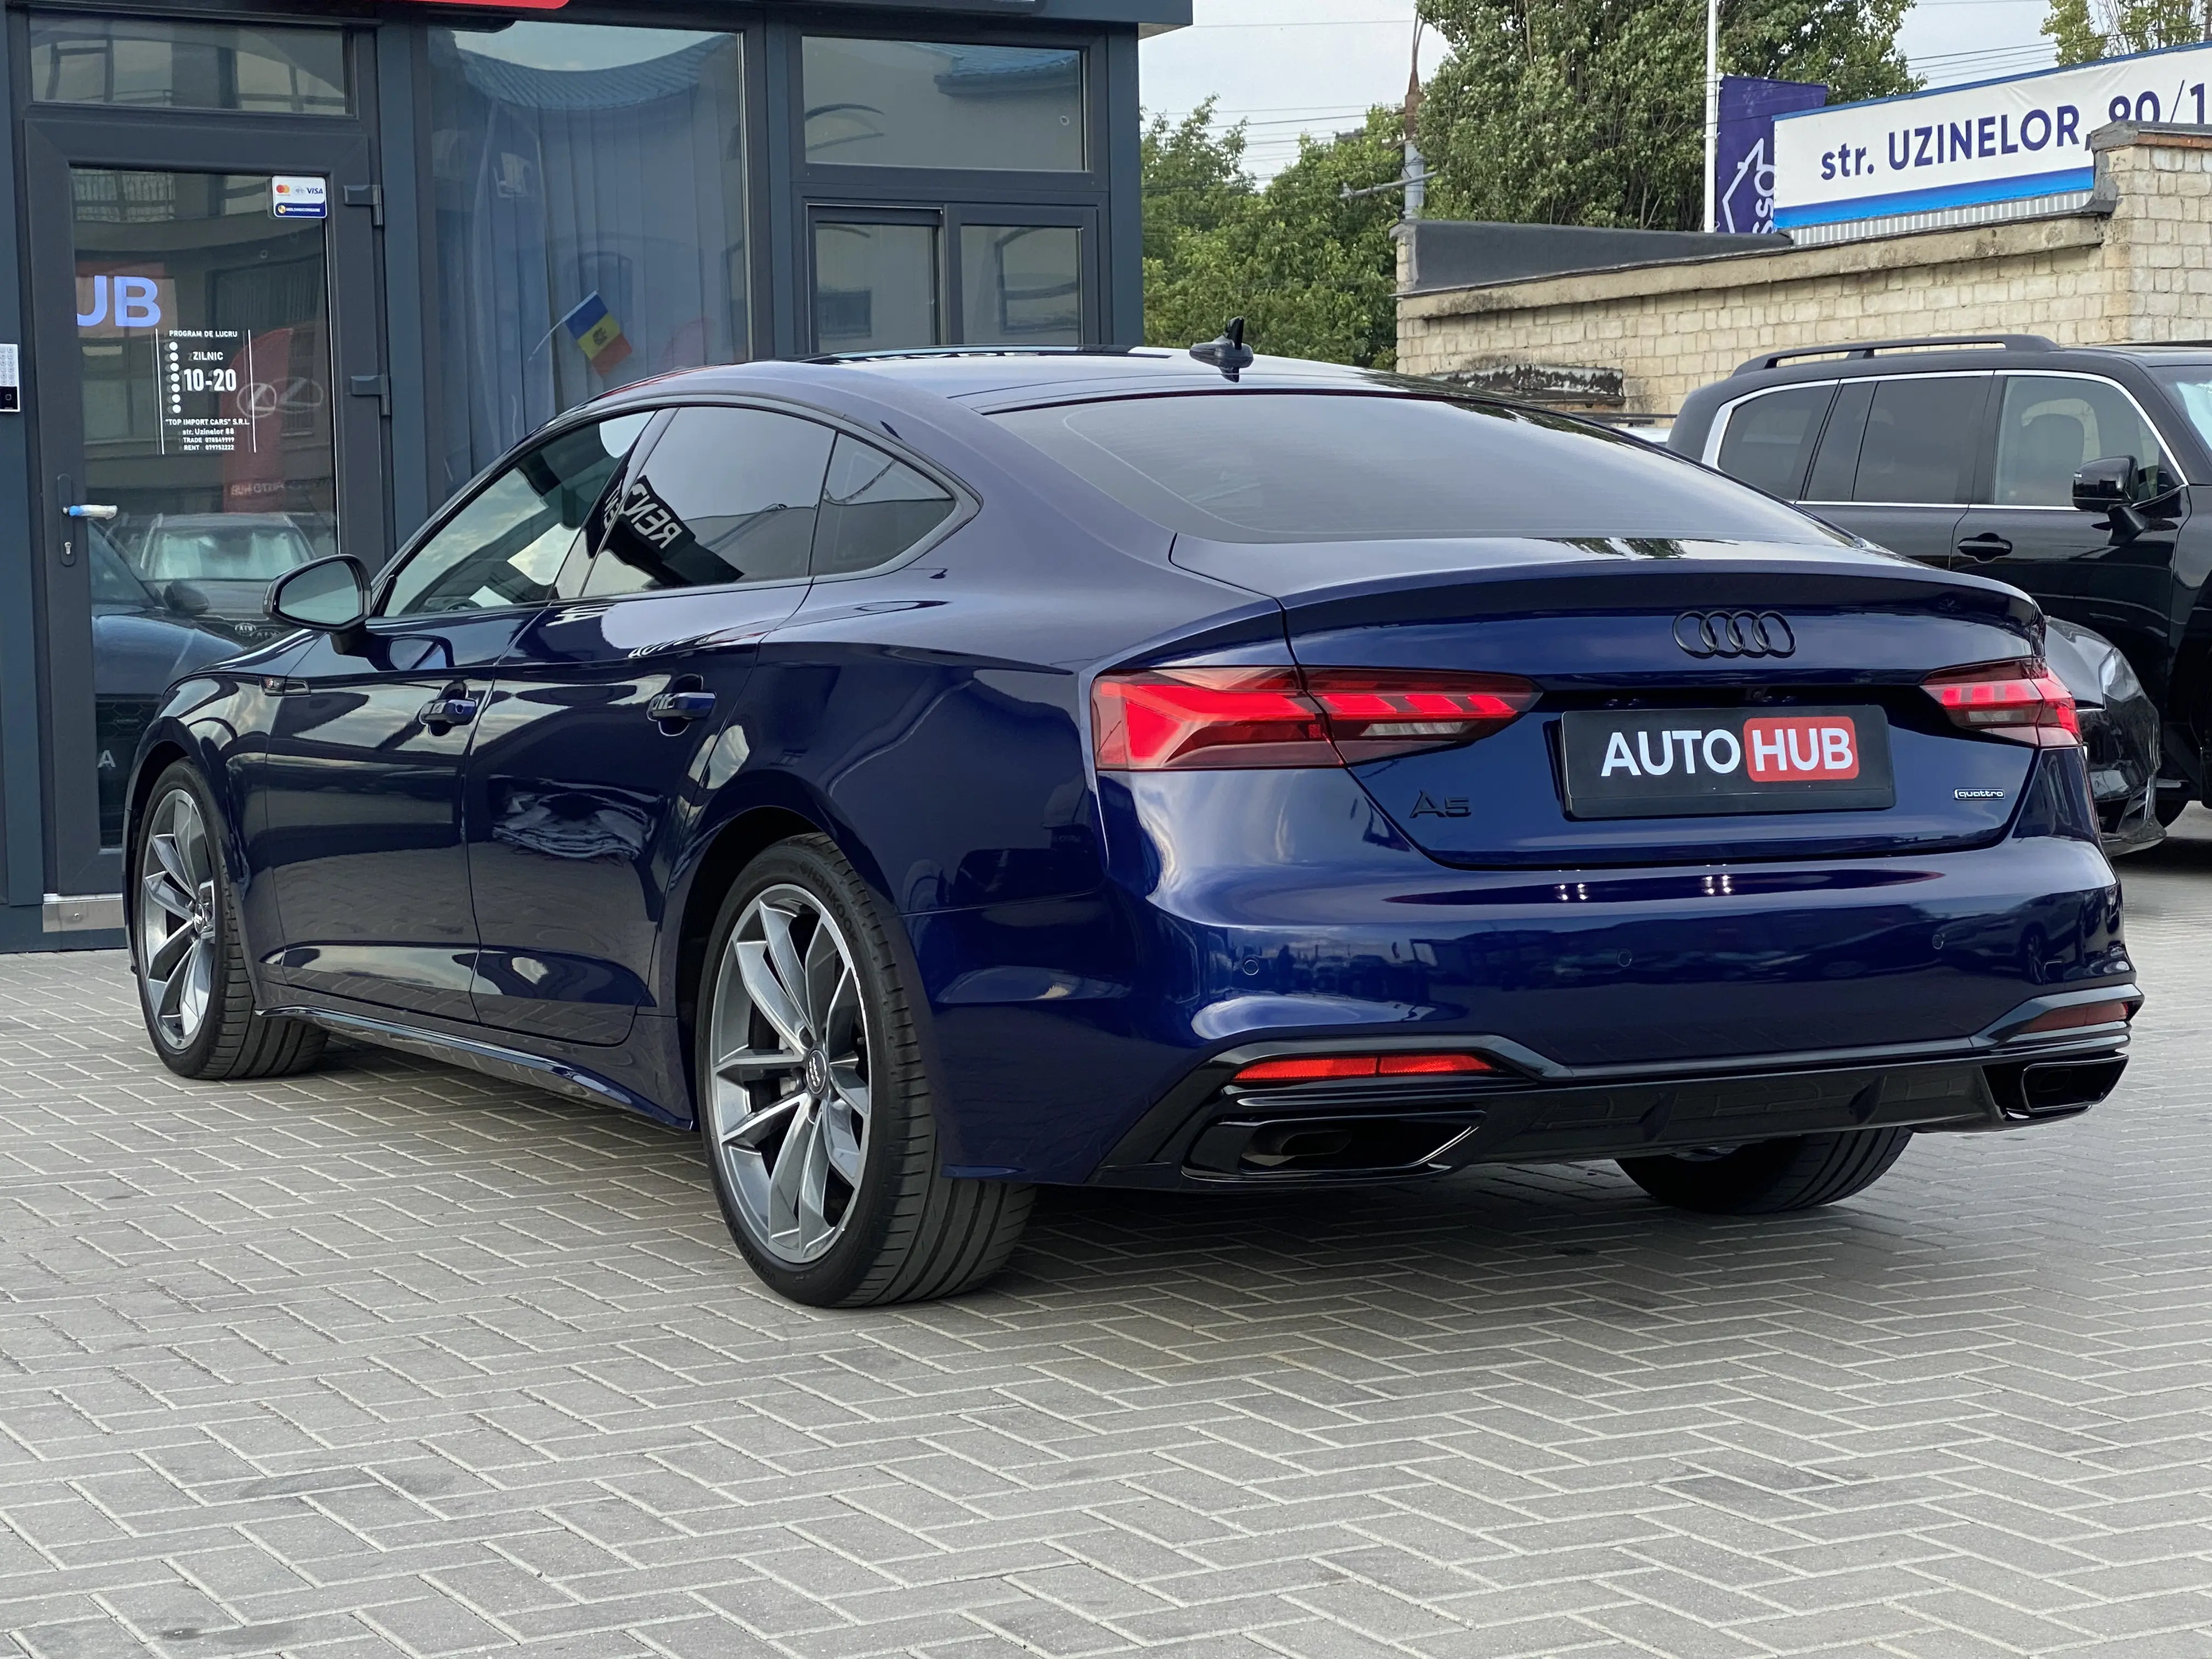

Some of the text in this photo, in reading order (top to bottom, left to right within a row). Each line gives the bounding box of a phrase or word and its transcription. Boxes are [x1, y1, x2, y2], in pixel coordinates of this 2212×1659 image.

[1821, 143, 1875, 180] str.
[193, 351, 223, 360] ZILNIC
[183, 368, 236, 391] 10-20
[1601, 727, 1853, 776] AUTO HUB
[1409, 790, 1471, 818] A5
